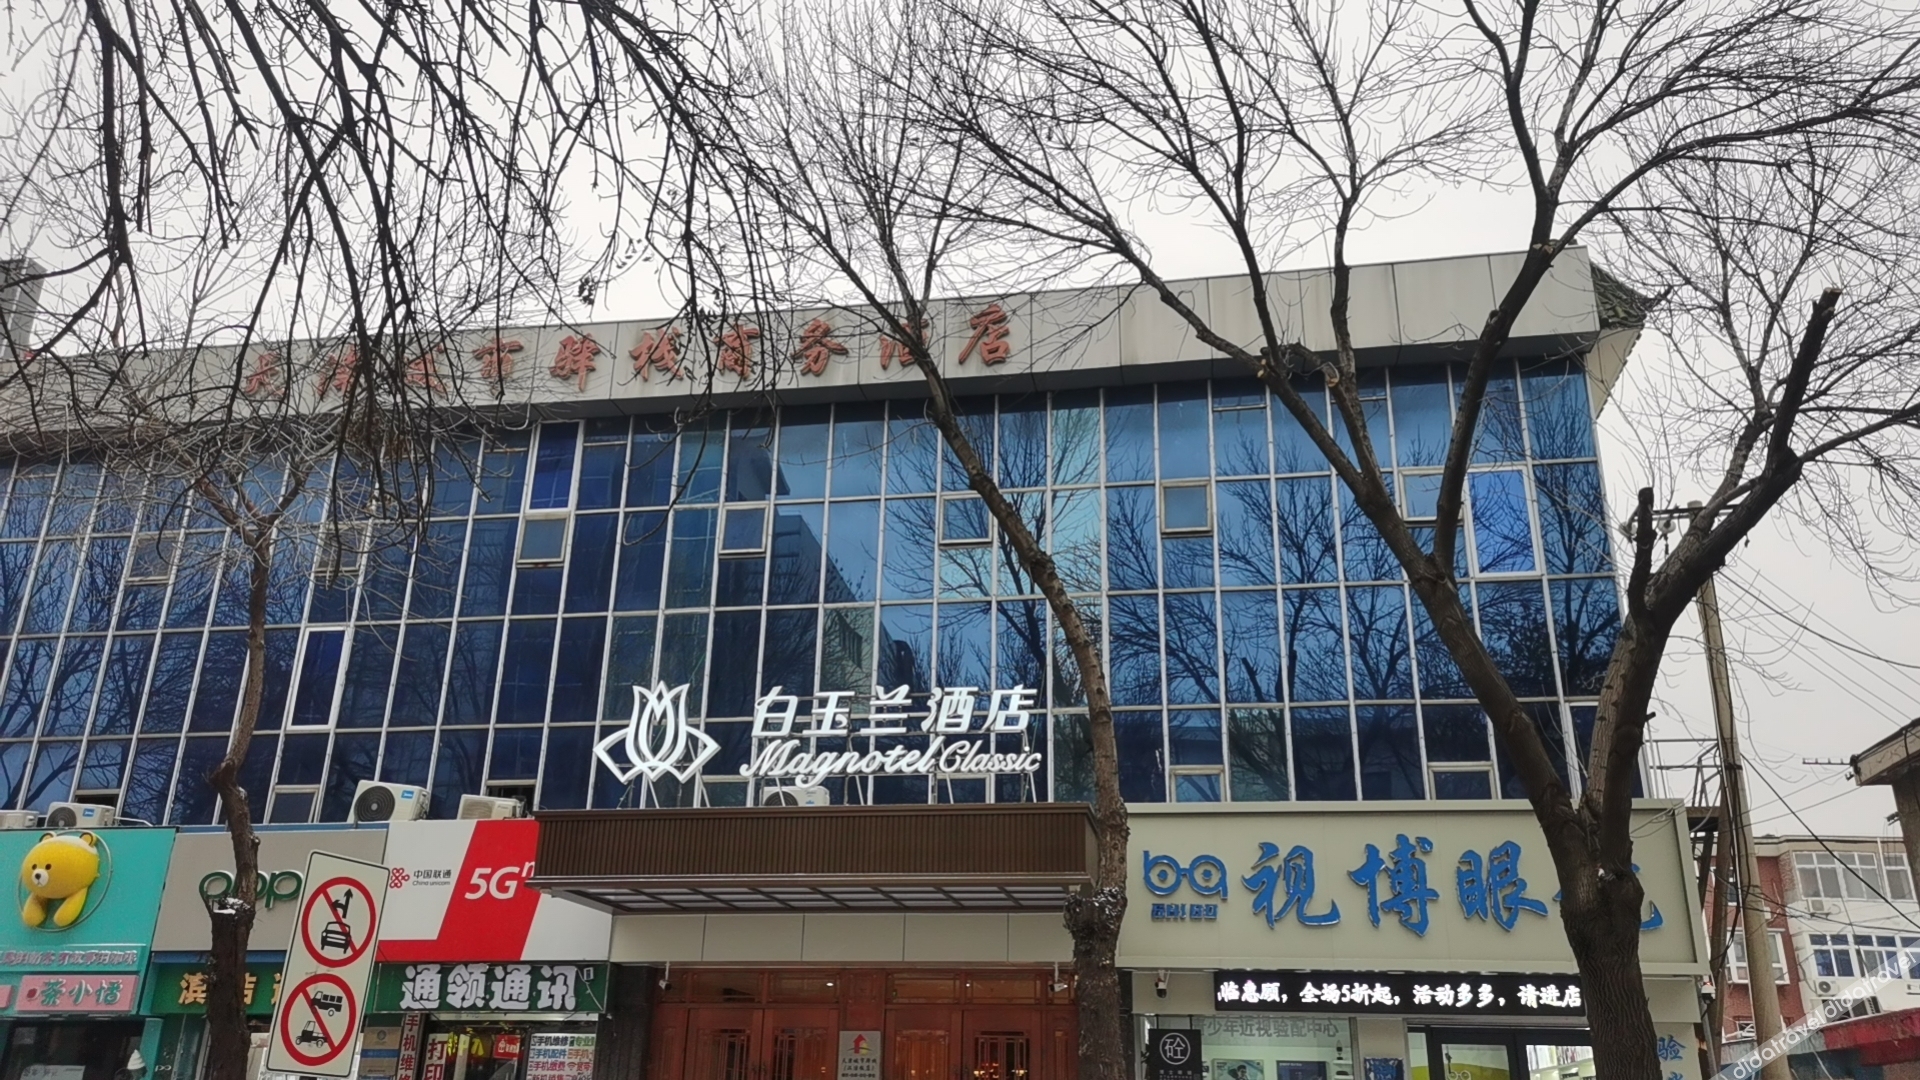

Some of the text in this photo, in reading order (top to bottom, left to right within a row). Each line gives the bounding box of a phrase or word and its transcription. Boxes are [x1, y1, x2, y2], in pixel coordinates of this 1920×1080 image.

[751, 684, 1037, 737] 白玉兰酒店
[739, 736, 1042, 788] Magnotel Classic
[413, 869, 452, 879] 中国联通
[1241, 833, 1664, 937] 视博眼
[400, 964, 577, 1010] 通领通讯
